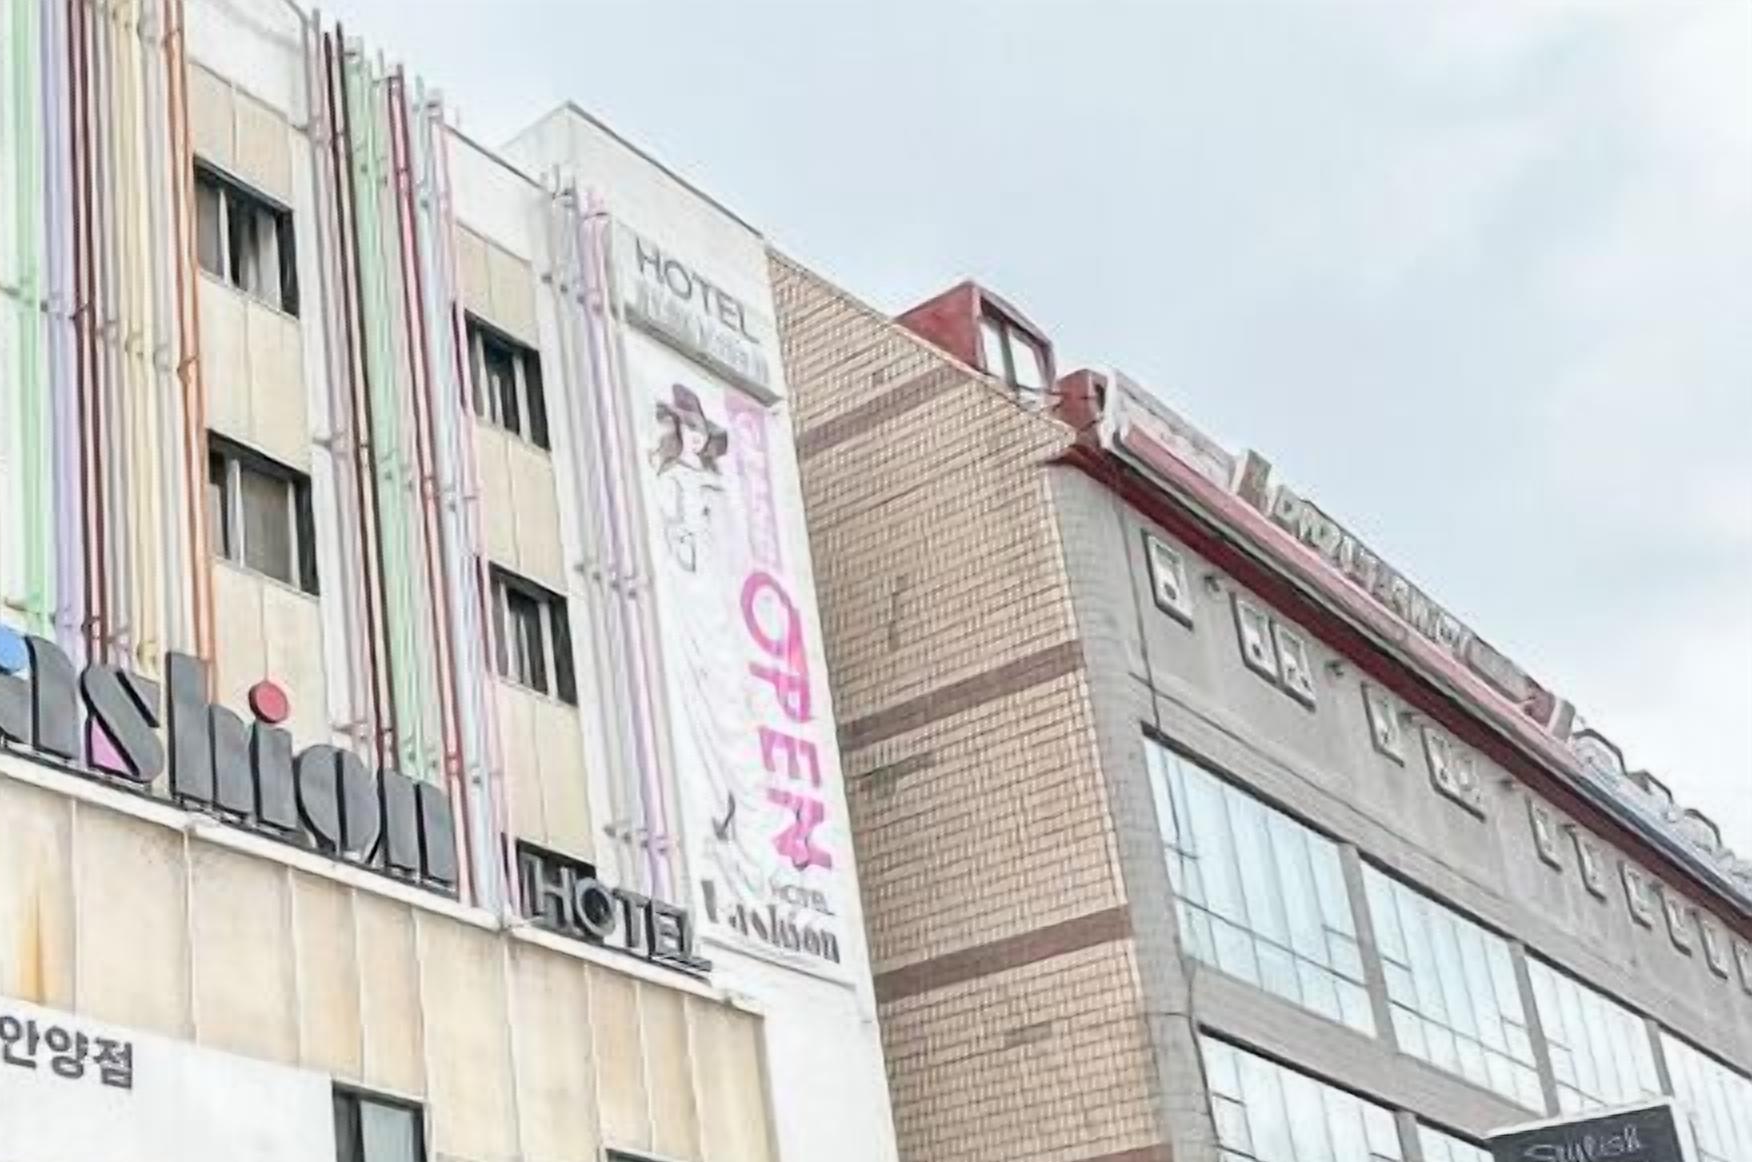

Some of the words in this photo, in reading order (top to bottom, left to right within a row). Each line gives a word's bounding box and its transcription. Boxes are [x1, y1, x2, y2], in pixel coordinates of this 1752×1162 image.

[634, 235, 761, 345] HOTEL
[740, 569, 833, 872] OPEN
[518, 853, 712, 972] HOTEL
